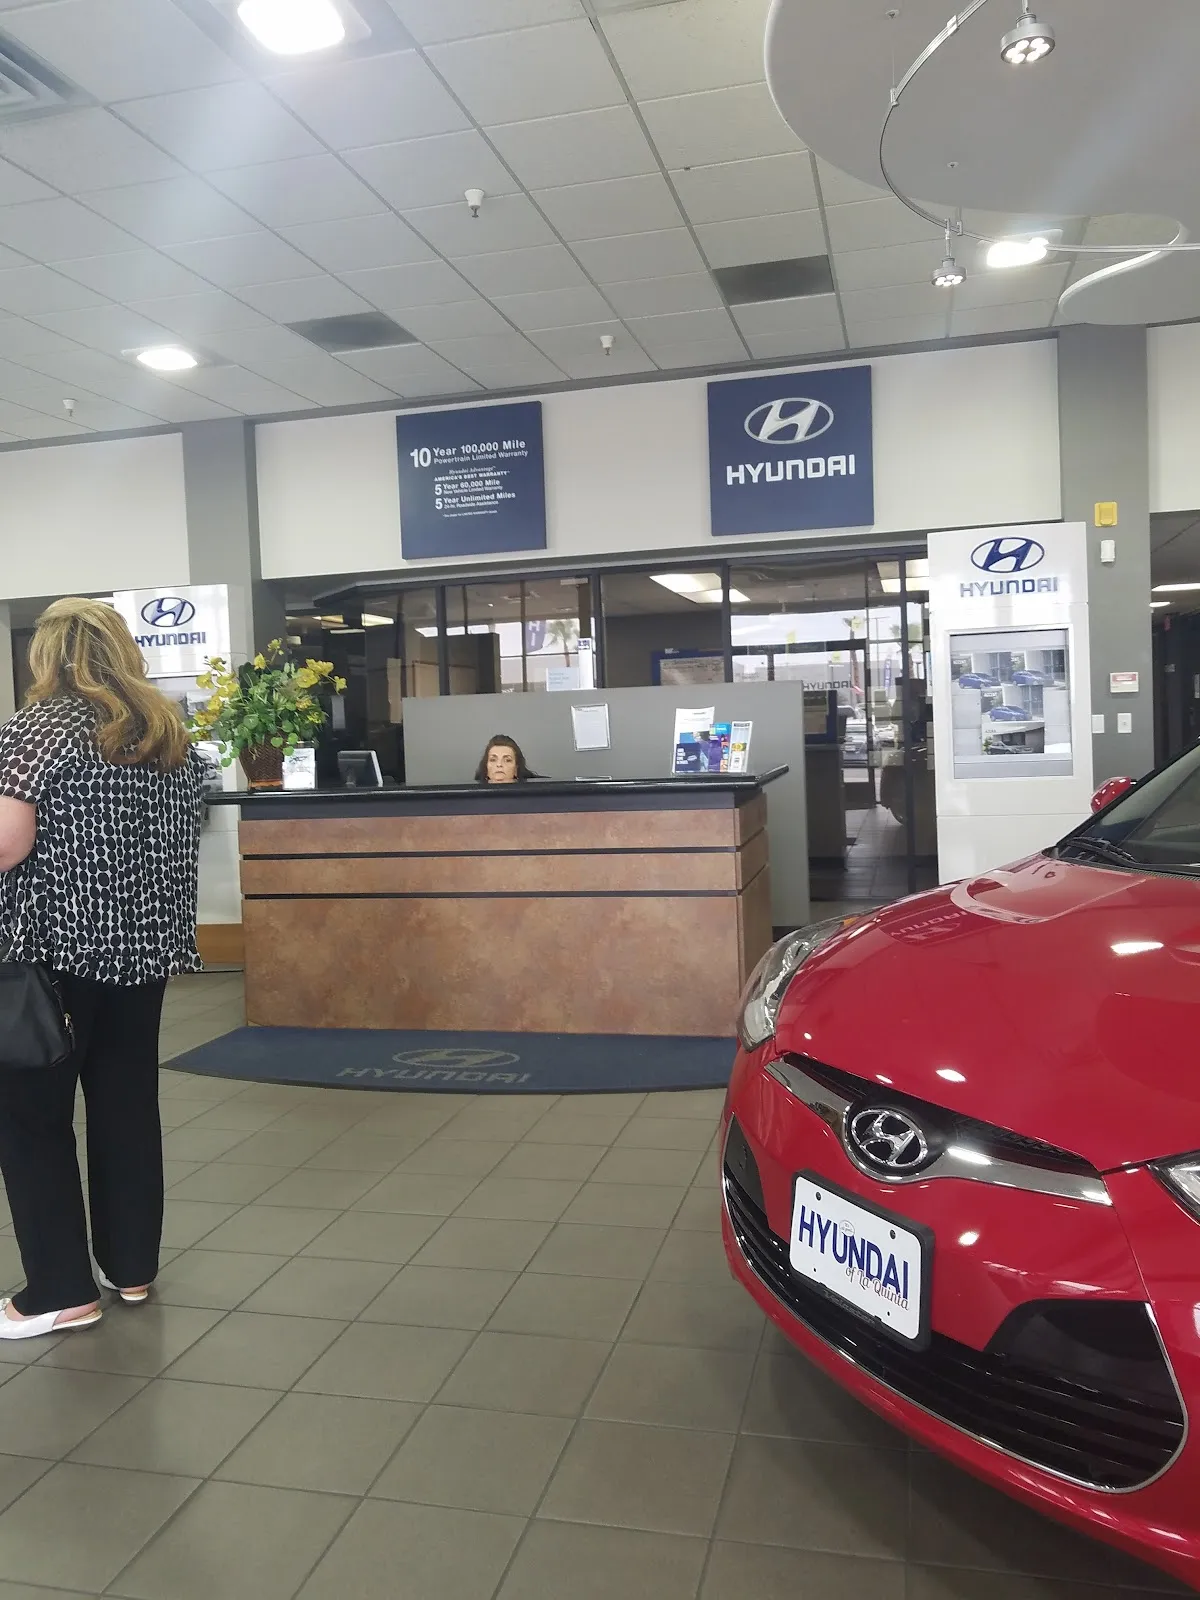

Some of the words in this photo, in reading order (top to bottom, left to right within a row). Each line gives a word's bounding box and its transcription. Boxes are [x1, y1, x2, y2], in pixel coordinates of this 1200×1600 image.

[410, 447, 431, 468] 10
[433, 447, 457, 457] Year
[460, 442, 499, 454] 100,000
[502, 440, 526, 450] Mile
[433, 455, 471, 464] Powertrain
[472, 452, 497, 460] Limited
[498, 450, 528, 458] Warranty
[726, 454, 856, 486] HYUNDAI
[434, 484, 443, 496] 5
[460, 480, 483, 489] 60,000
[485, 479, 500, 487] Mile
[435, 498, 443, 510] 5
[443, 496, 459, 504] Year
[460, 493, 495, 502] Unlimited
[496, 491, 516, 499] Miles
[959, 576, 1058, 597] HYUNDAI
[134, 631, 207, 648] HYUNDAI
[335, 1067, 532, 1084] HYUNDAI
[798, 1204, 909, 1300] HYUNDAI
[845, 1266, 856, 1283] of
[857, 1268, 870, 1291] La
[872, 1277, 910, 1311] Quinta
